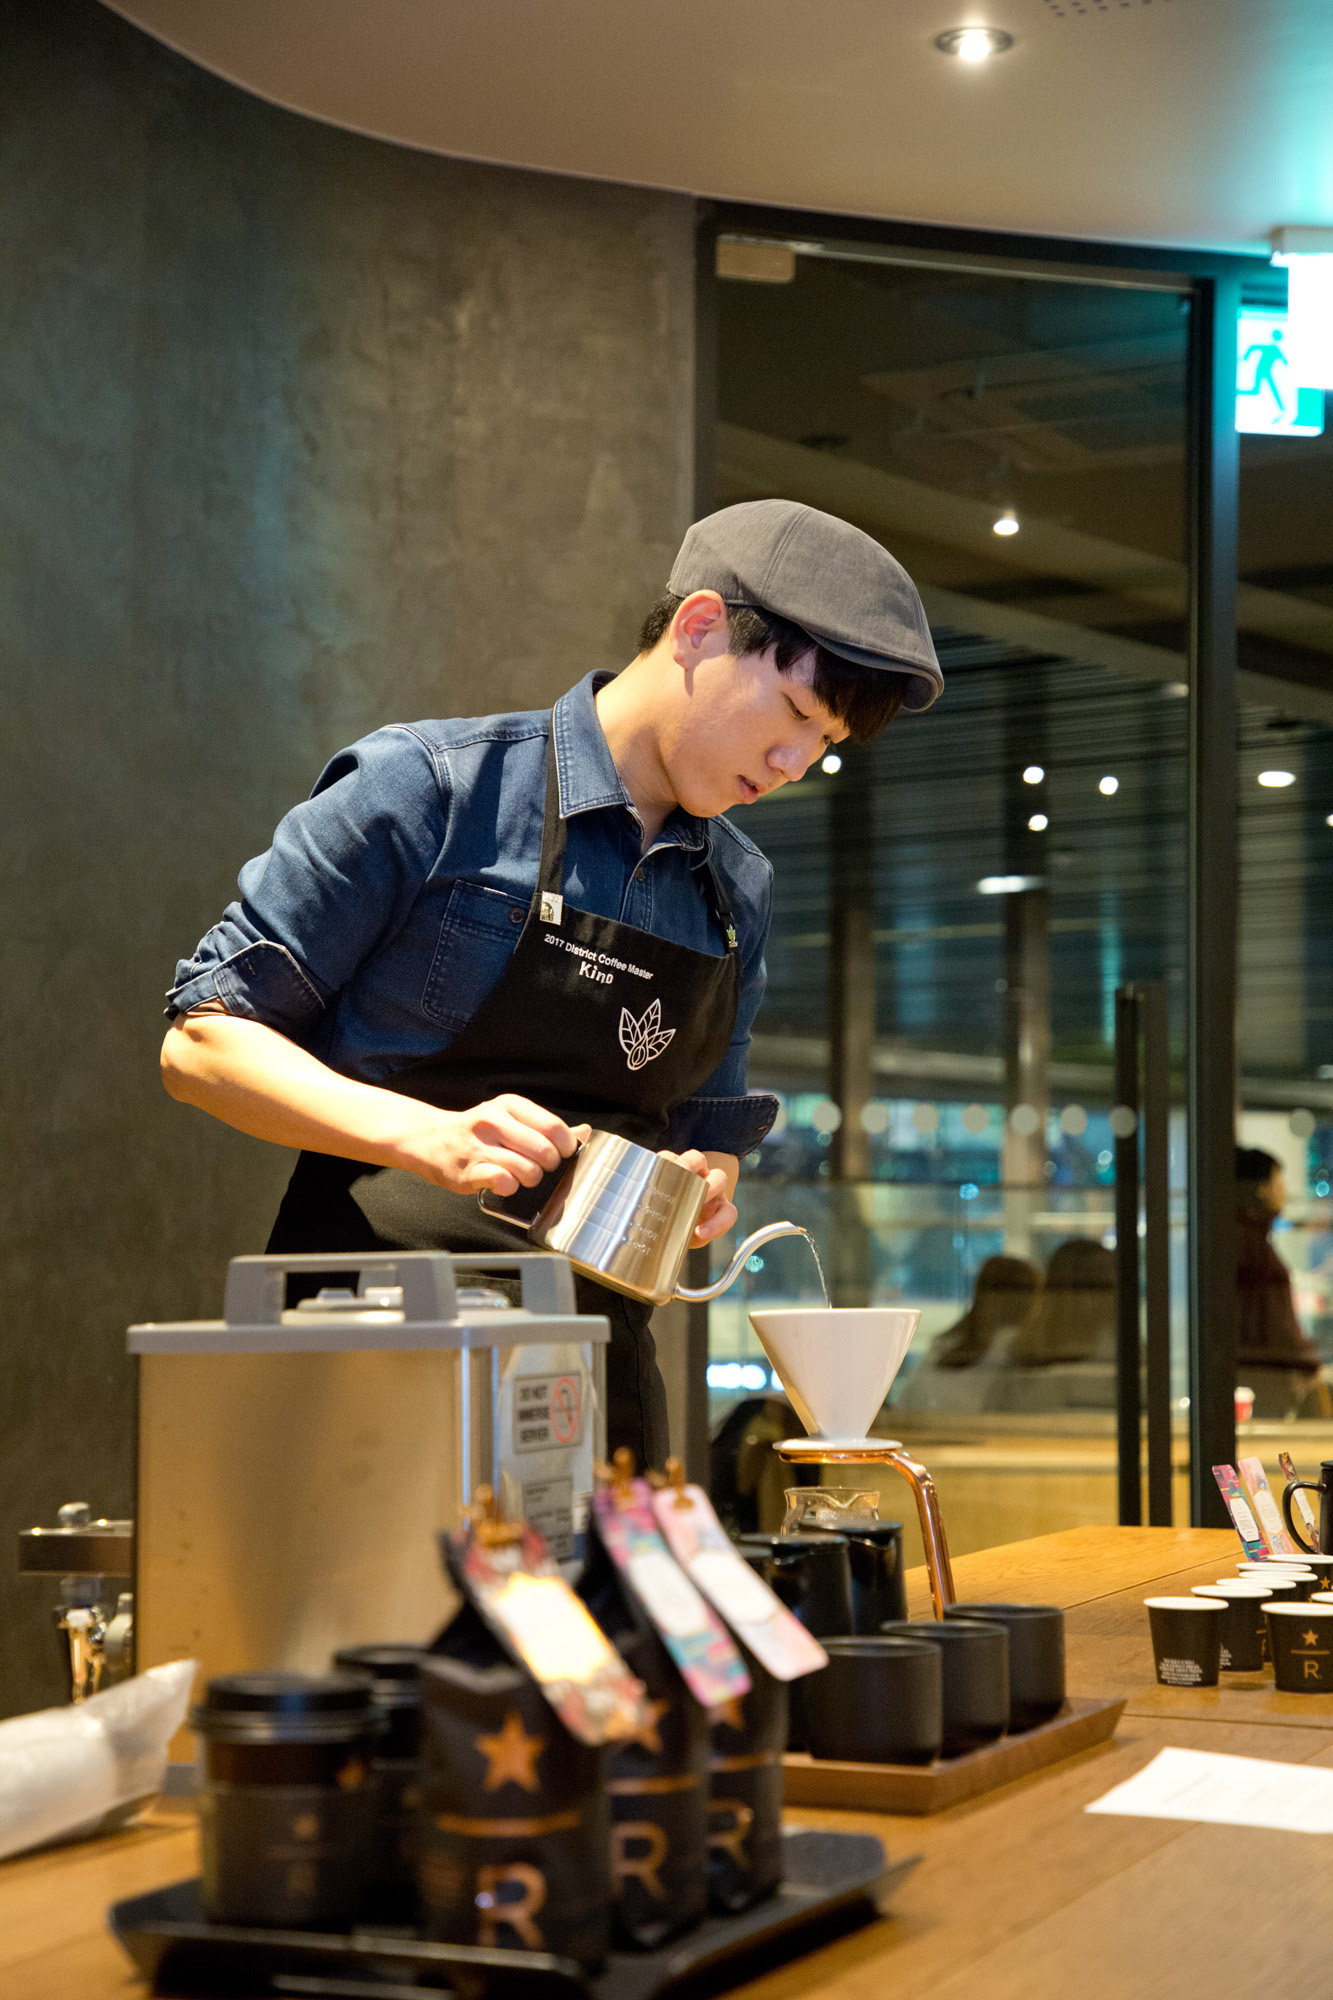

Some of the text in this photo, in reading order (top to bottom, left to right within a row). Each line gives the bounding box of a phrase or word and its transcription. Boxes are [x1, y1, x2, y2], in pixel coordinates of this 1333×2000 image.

[544, 933, 654, 980] 2017 District Coffee Master
[578, 961, 614, 984] Kino
[1303, 1660, 1320, 1679] R
[609, 1820, 669, 1898] R
[475, 1861, 548, 1948] R
